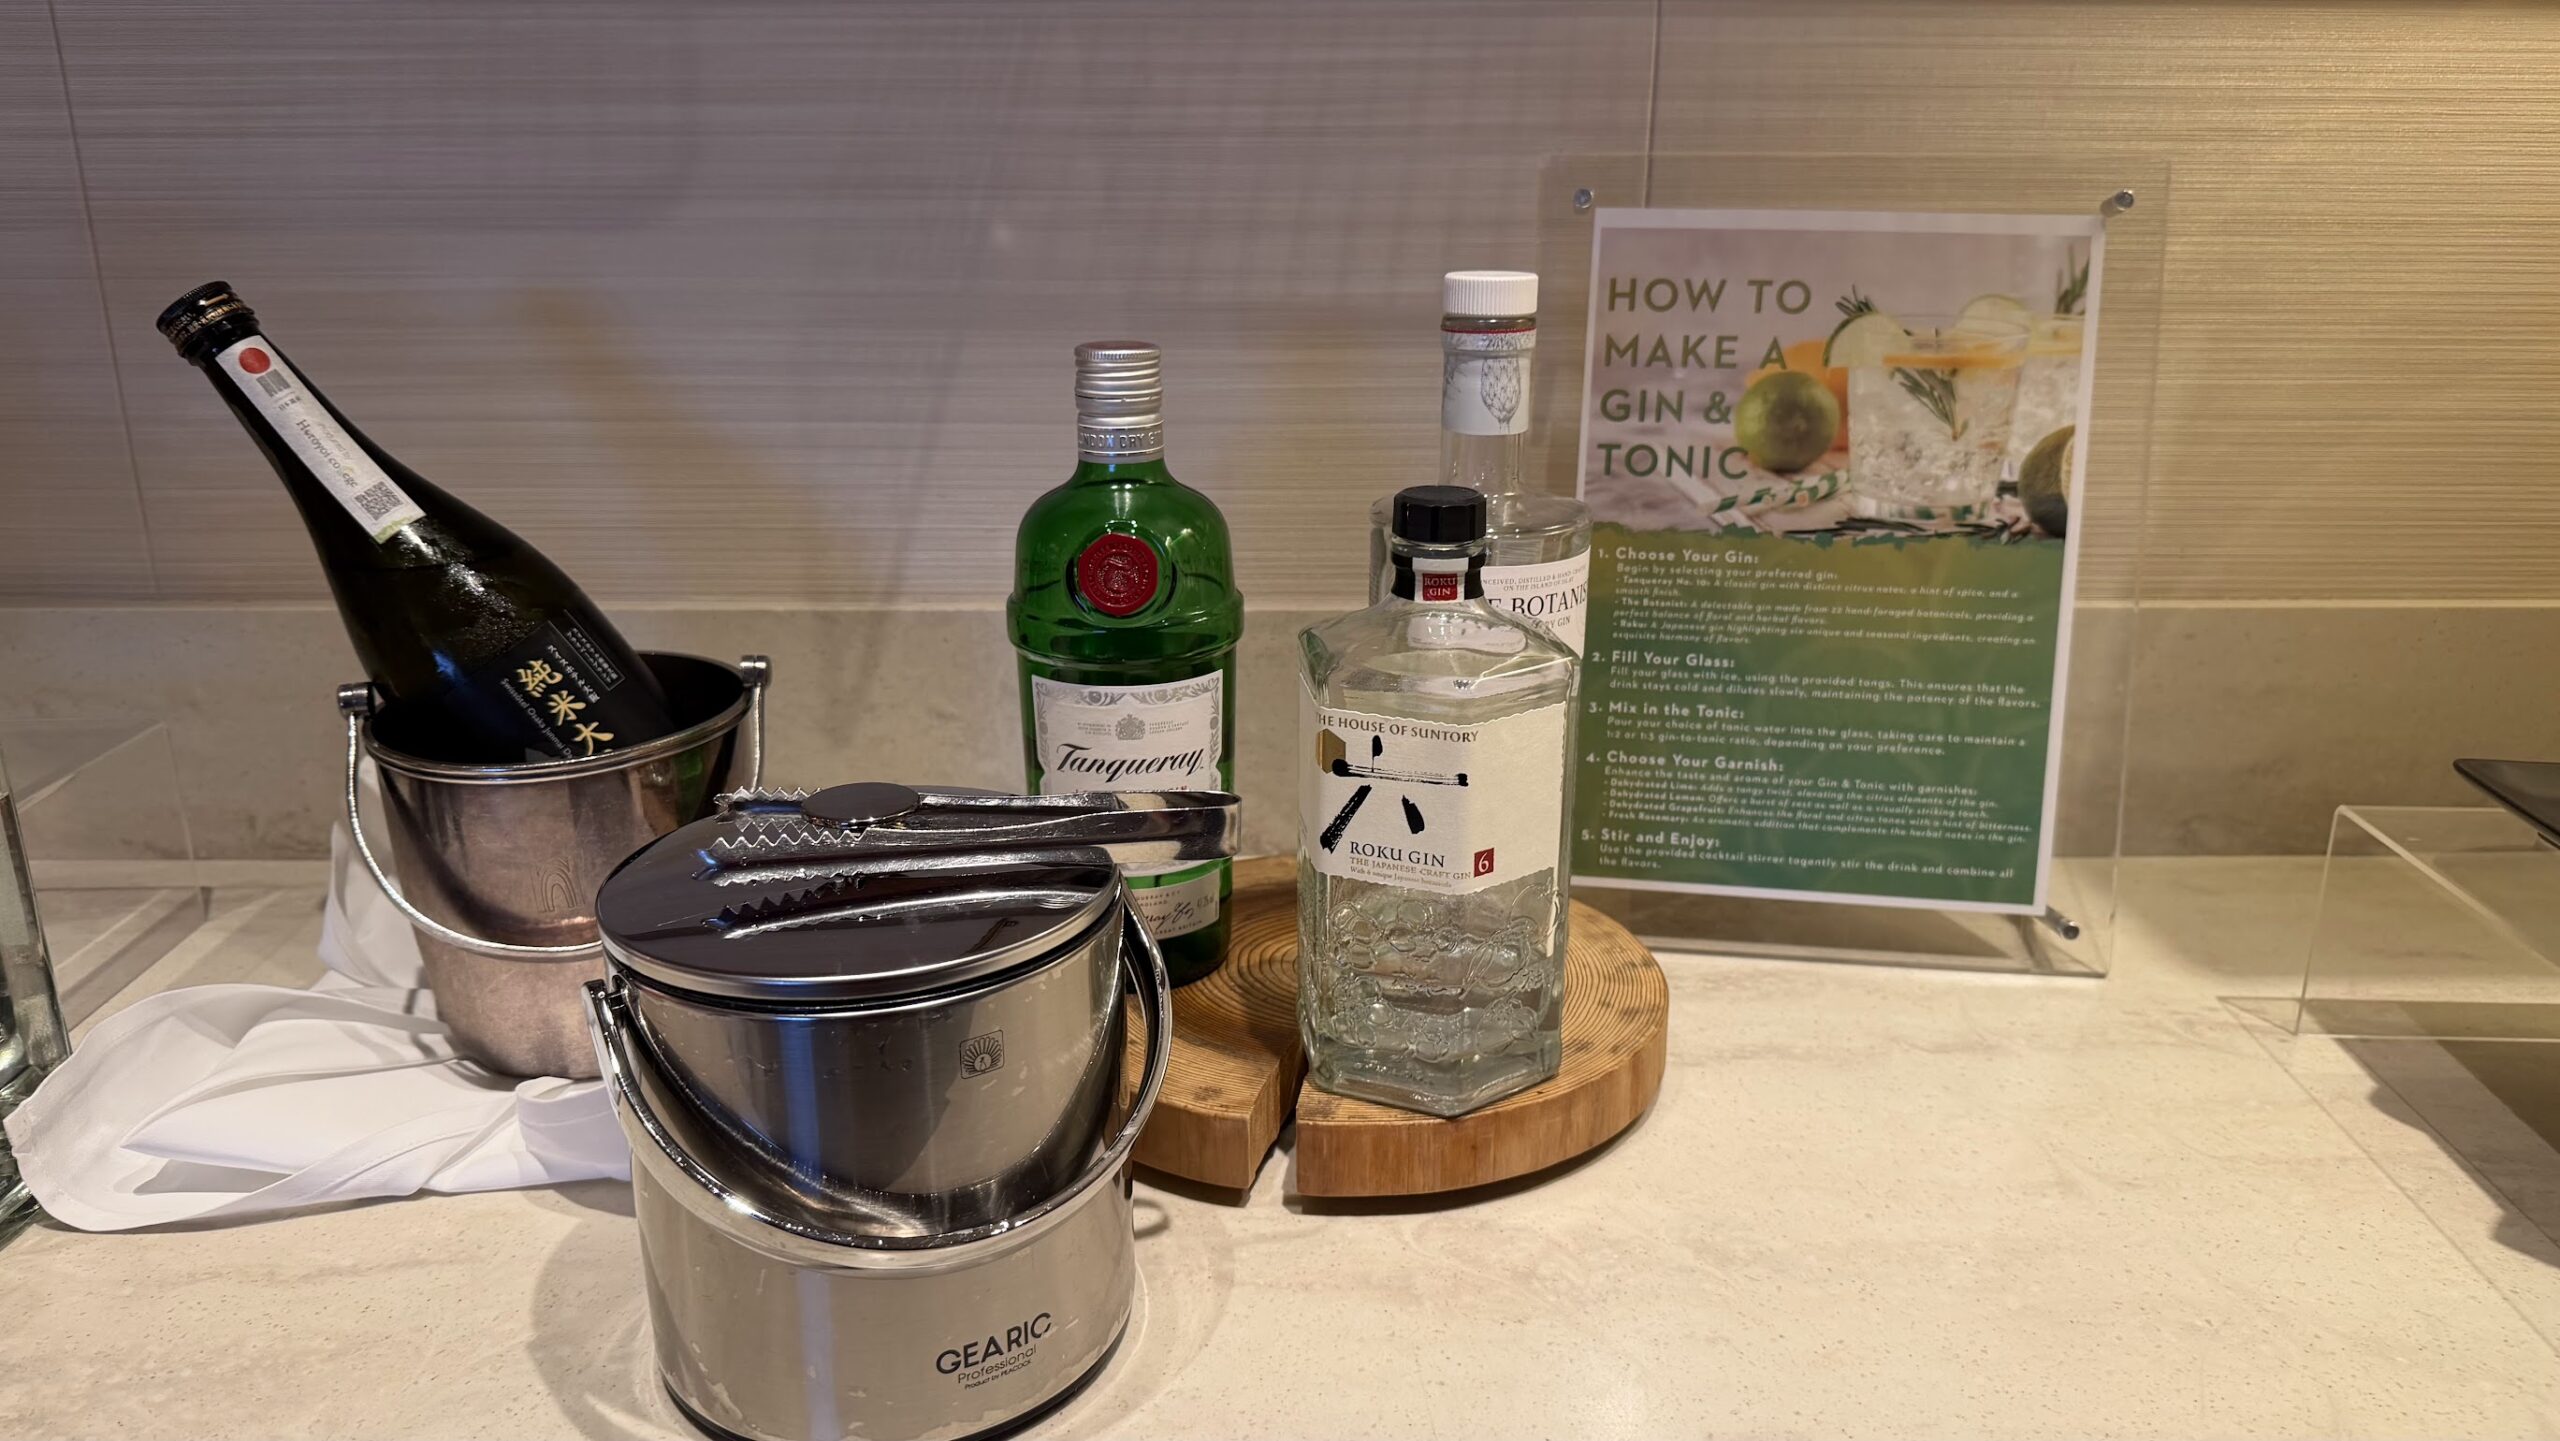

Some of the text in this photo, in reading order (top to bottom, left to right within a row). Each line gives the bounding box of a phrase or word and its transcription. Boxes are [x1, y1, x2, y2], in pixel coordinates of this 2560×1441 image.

[1608, 278, 1812, 315] HOW TO
[1605, 335, 1787, 369] MAKE A
[1601, 390, 1731, 425] GIN &
[1598, 443, 1748, 480] TONIC
[1598, 547, 1759, 564] 1. Choose Your Gin:
[1424, 577, 1456, 586] ROKU
[1483, 578, 1516, 586] NCEIVED,
[1617, 563, 1838, 582] Begin by selecting your preferred gin:
[1429, 587, 1451, 596] GIN
[1511, 580, 1587, 619] BOTANIS
[1557, 615, 1571, 627] GIN
[1592, 650, 1736, 668] 2. Fill Your Glass:
[1609, 679, 1638, 690] drink
[1642, 682, 1671, 692] stays
[1674, 682, 1698, 692] cold
[1702, 683, 1722, 693] and
[1726, 684, 1765, 695] dilutes
[1812, 689, 1879, 703] maintaining
[1884, 691, 1903, 701] the
[1907, 694, 1953, 706] potency
[1958, 694, 1970, 705] of
[1974, 696, 1993, 706] the
[1610, 666, 1628, 676] Fill
[1632, 669, 1657, 679] your
[1661, 668, 1689, 680] glass
[1693, 670, 1716, 681] with
[1745, 673, 1775, 685] using
[1779, 673, 1799, 684] the
[1801, 675, 1855, 688] provided
[1900, 678, 1924, 690] This
[1927, 682, 1972, 692] ensures
[1977, 682, 2001, 693] that
[2005, 684, 2025, 694] the
[515, 657, 615, 756] 純米大
[1588, 701, 1744, 719] 3. Mix in the Tonic:
[1338, 717, 1385, 733] HOUSE
[1389, 723, 1408, 736] OF
[1411, 726, 1479, 743] SUNTORY
[1607, 716, 1632, 727] Pour
[1637, 719, 1661, 729] your
[1665, 719, 1701, 730] choice
[1706, 721, 1717, 731] of
[1722, 722, 1749, 733] tonic
[1754, 725, 1787, 734] water
[1790, 724, 1814, 735] into
[1817, 726, 1836, 737] the
[1878, 729, 1914, 742] taking
[1918, 733, 1944, 742] care
[1948, 733, 1960, 743] to
[1964, 734, 2015, 746] maintain
[2018, 738, 2026, 747] a
[1624, 732, 1635, 740] or
[1658, 733, 1726, 744] gin-to-tonic
[1763, 737, 1825, 750] depending
[1829, 742, 1842, 750] on
[1847, 743, 1872, 753] your
[1585, 750, 1784, 772] 4. Choose Your Garnish:
[1604, 766, 1651, 778] Enhance
[1655, 768, 1672, 779] the
[1677, 770, 1705, 781] taste
[1710, 771, 1730, 782] and
[1734, 774, 1768, 784] aroma
[1772, 774, 1783, 784] of
[1787, 778, 1814, 787] your
[1817, 777, 1837, 788] Gin
[1841, 779, 1850, 789] &
[1854, 779, 1886, 791] Tonic
[1889, 781, 1913, 792] with
[1580, 828, 1721, 849] 5. Stir and Enjoy:
[1350, 841, 1445, 868] ROKU GIN
[1478, 852, 1489, 873] 6
[1599, 856, 1661, 869] the flavors.
[1600, 843, 1620, 854] Use
[1624, 844, 1642, 855] the
[1646, 845, 1695, 858] provided
[1699, 849, 1744, 861] cocktail
[1747, 852, 1786, 863] stirrer
[1840, 858, 1859, 869] stir
[1864, 860, 1883, 871] the
[1888, 861, 1918, 872] drink
[1921, 864, 1943, 875] and
[1946, 865, 1996, 877] combine
[1999, 867, 2014, 878] all
[1350, 856, 1471, 880] THE JAPANESE CRAFT GIN
[936, 1311, 1052, 1375] GEARIC
[958, 1343, 1037, 1384] Professional
[964, 1377, 990, 1390] Product
[1001, 1359, 1032, 1377] PEACOCK
